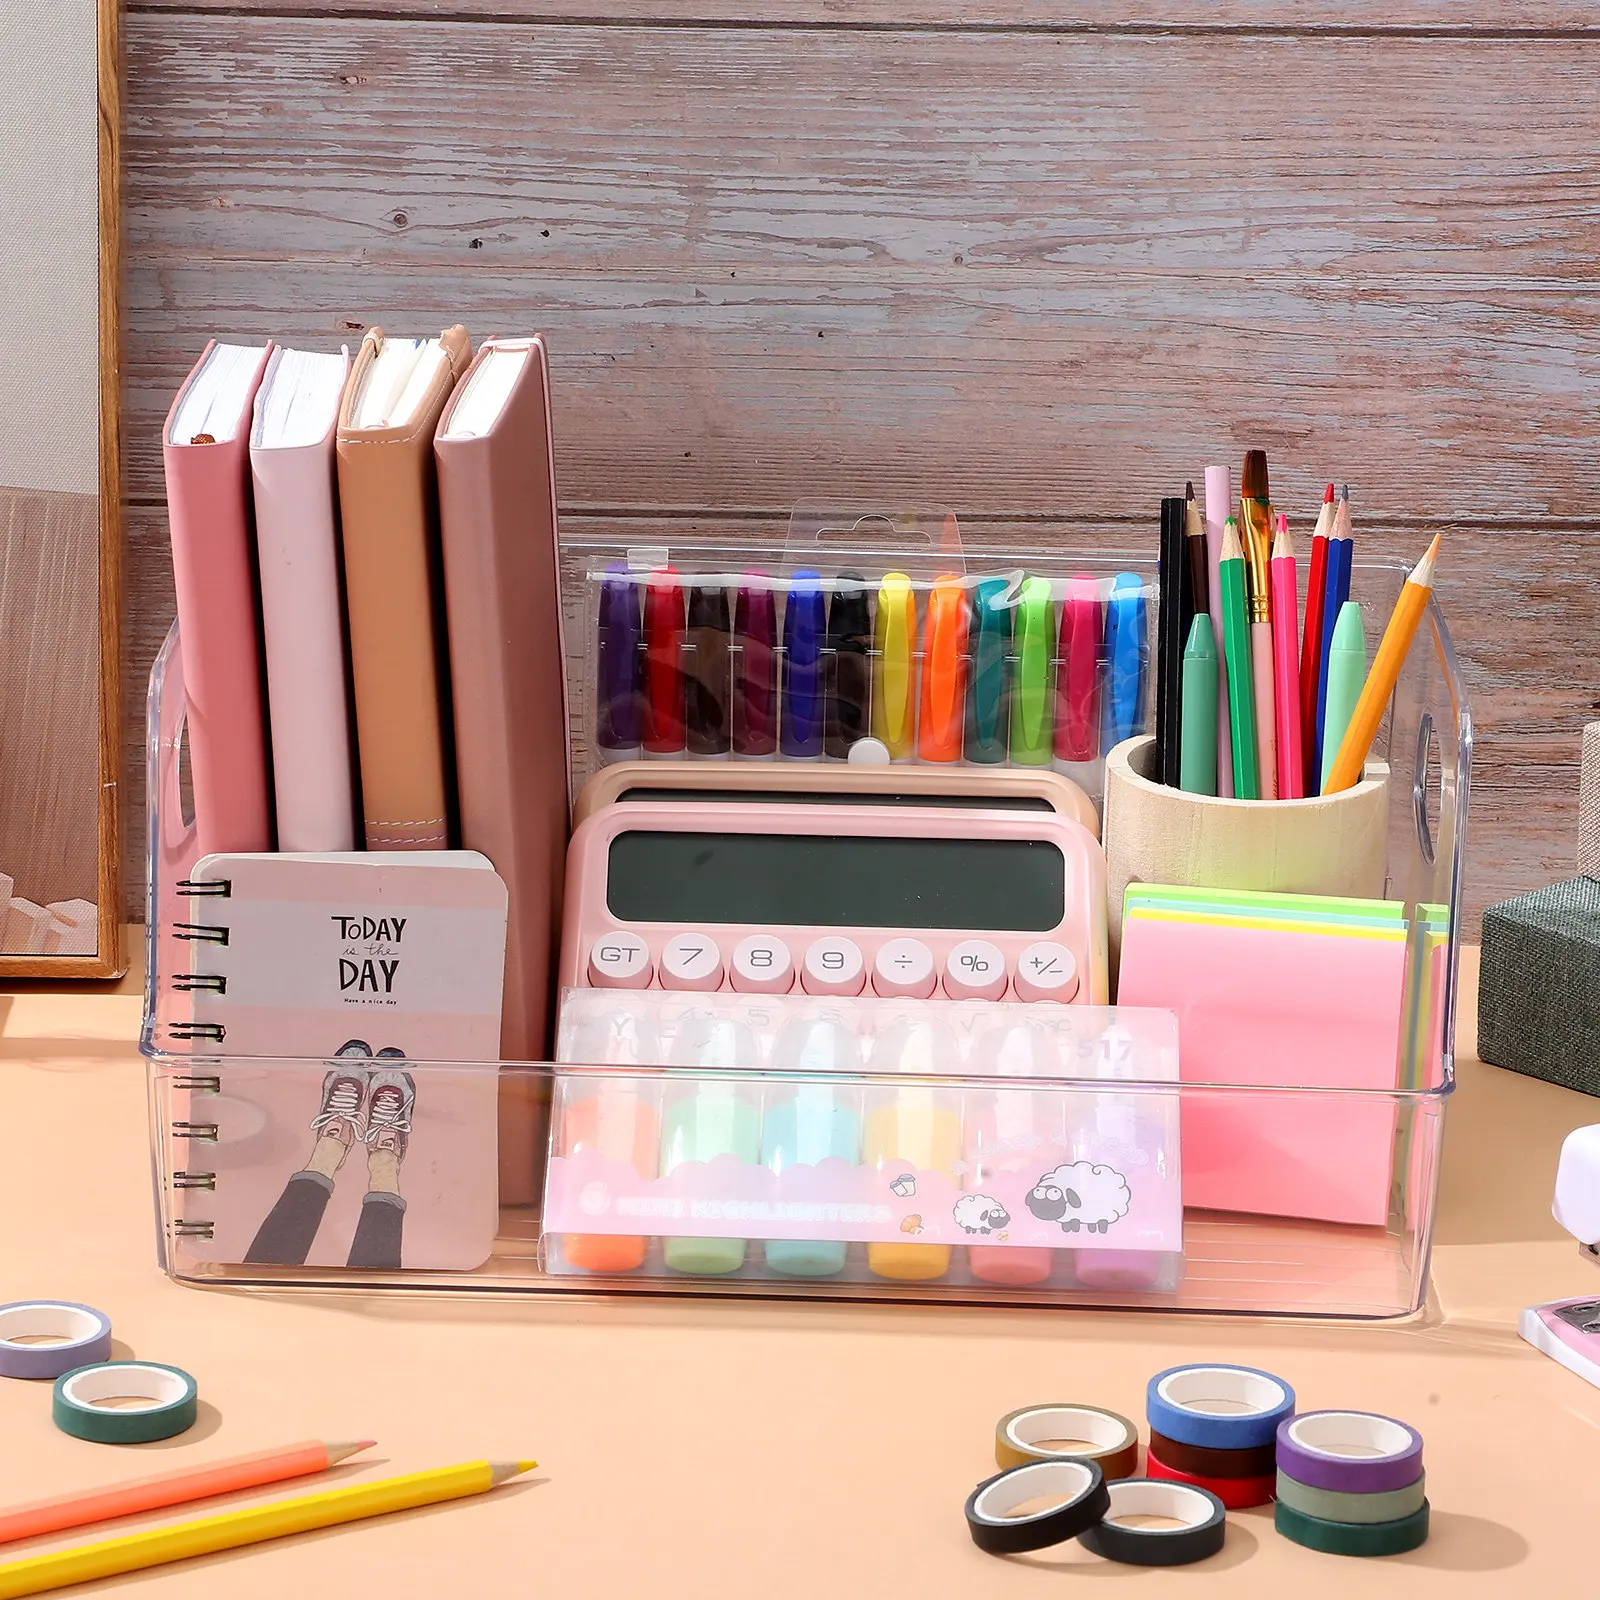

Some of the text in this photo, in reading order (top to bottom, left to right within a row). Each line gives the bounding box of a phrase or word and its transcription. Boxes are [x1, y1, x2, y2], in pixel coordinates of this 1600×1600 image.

[342, 943, 399, 956] is the
[600, 946, 641, 963] GT
[679, 948, 704, 966] 7
[750, 949, 773, 967] 8
[822, 951, 844, 969] 9
[960, 954, 989, 972] %
[339, 958, 400, 993] DAY
